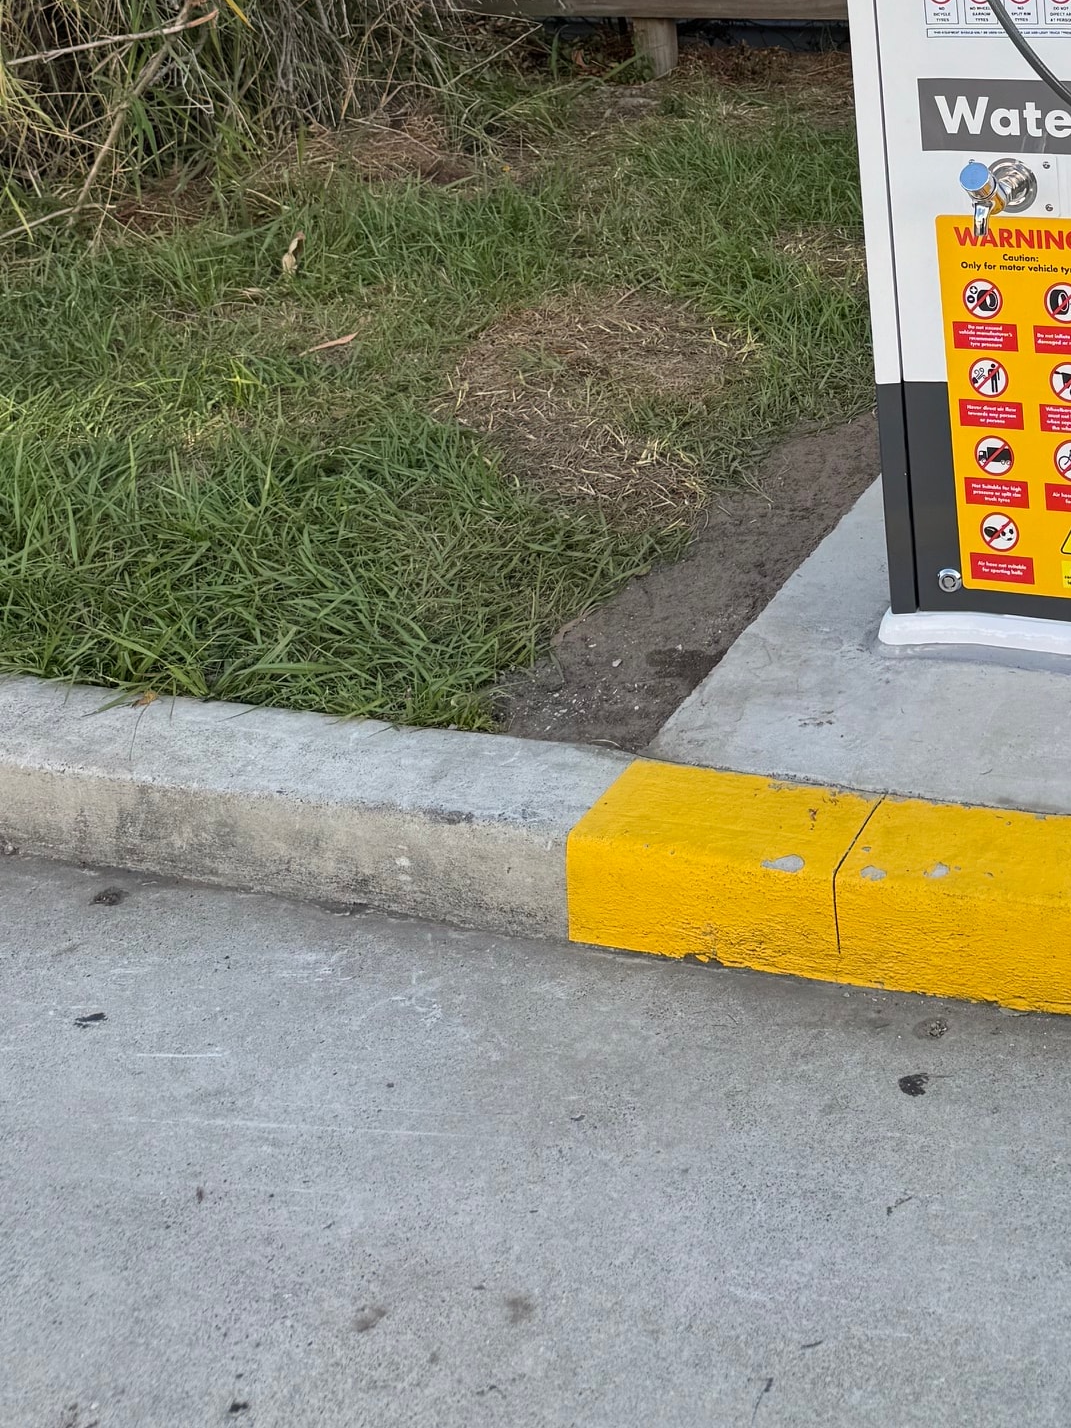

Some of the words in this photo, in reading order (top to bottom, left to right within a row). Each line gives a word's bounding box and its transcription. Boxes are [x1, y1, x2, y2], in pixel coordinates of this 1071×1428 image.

[1002, 253, 1039, 262] Caution:
[960, 261, 982, 271] Only
[984, 262, 997, 270] for
[999, 264, 1025, 272] motor
[1027, 264, 1059, 273] vehicle
